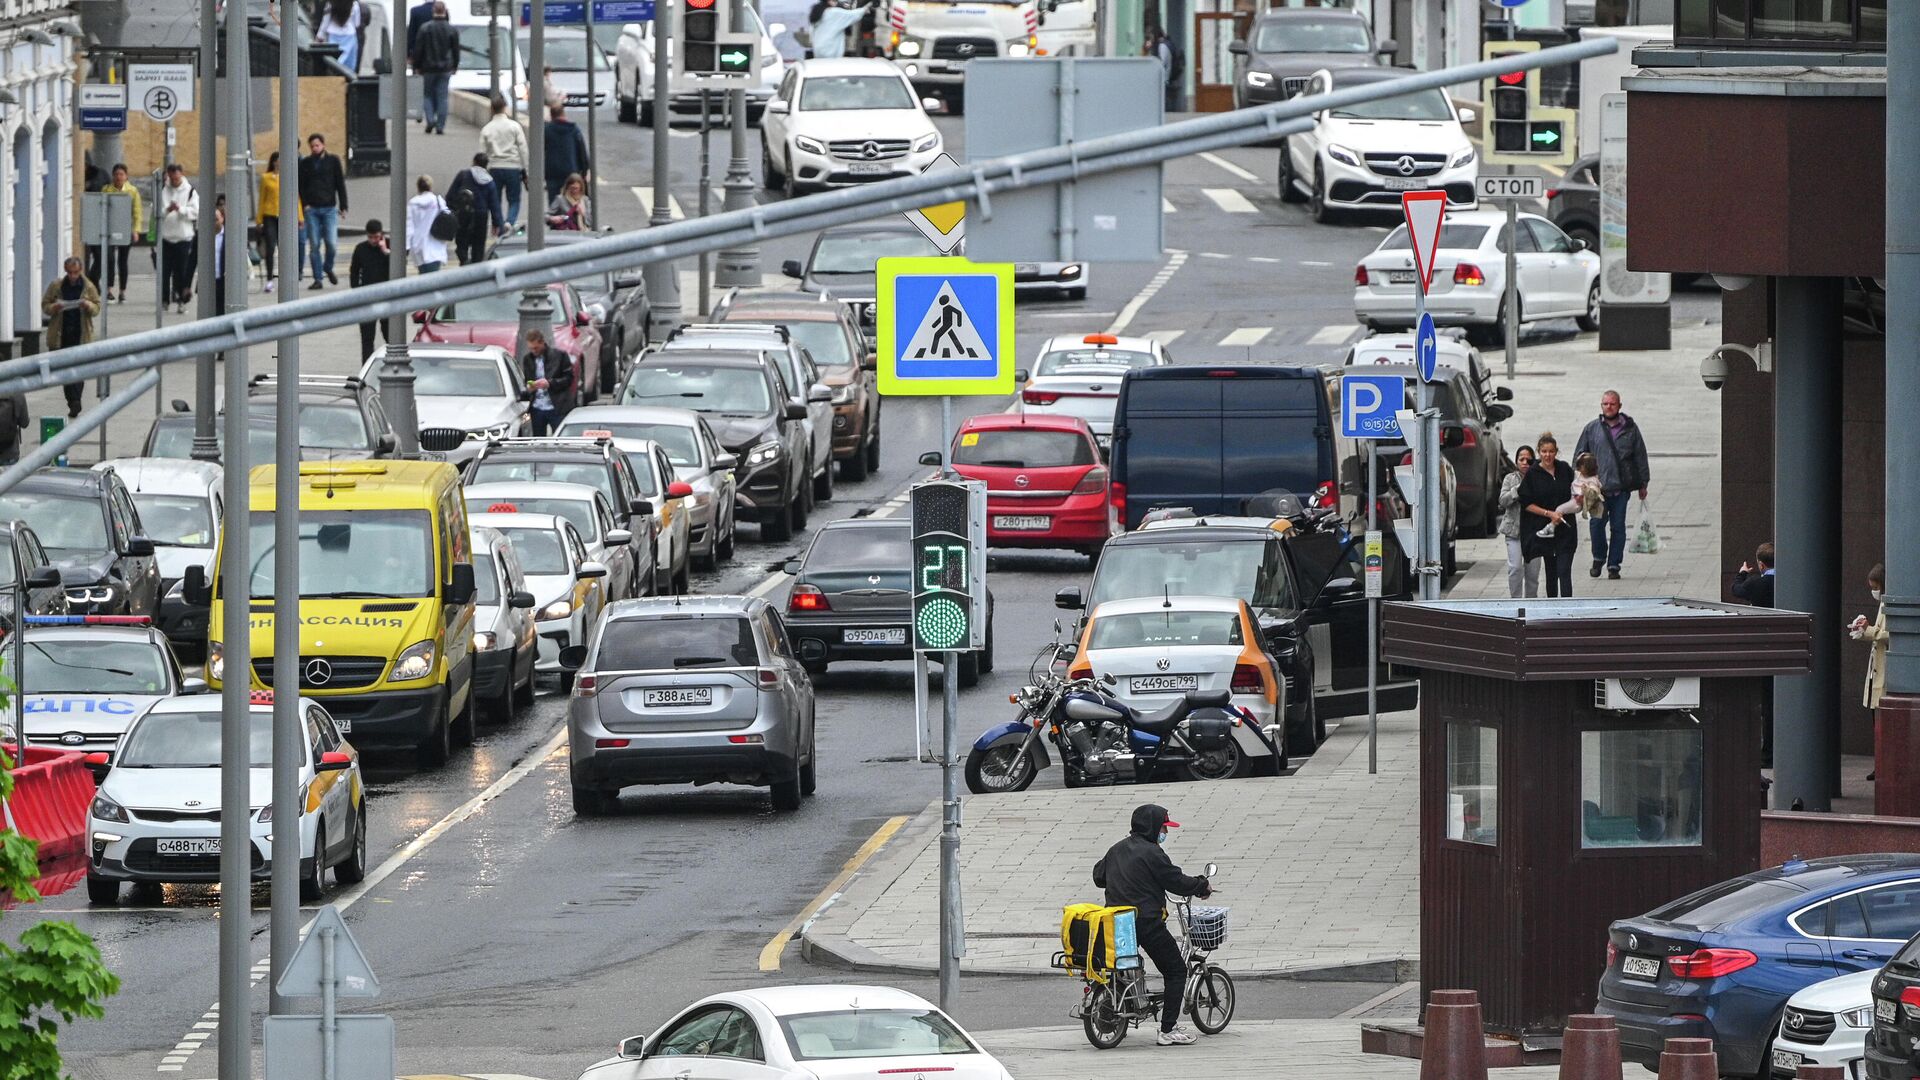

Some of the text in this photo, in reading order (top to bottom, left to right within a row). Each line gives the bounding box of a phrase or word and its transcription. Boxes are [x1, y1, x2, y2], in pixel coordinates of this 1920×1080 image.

[1485, 179, 1534, 195] СТОП
[1348, 382, 1383, 431] P
[1364, 419, 1397, 429] 10 15 20
[923, 545, 966, 589] 27
[847, 629, 903, 641] О950АВ 177
[1133, 675, 1194, 689] С449ОЕ 799
[649, 688, 708, 702] Р388АЕ 40
[23, 699, 135, 715] ДПС
[160, 840, 205, 852] О488ТК
